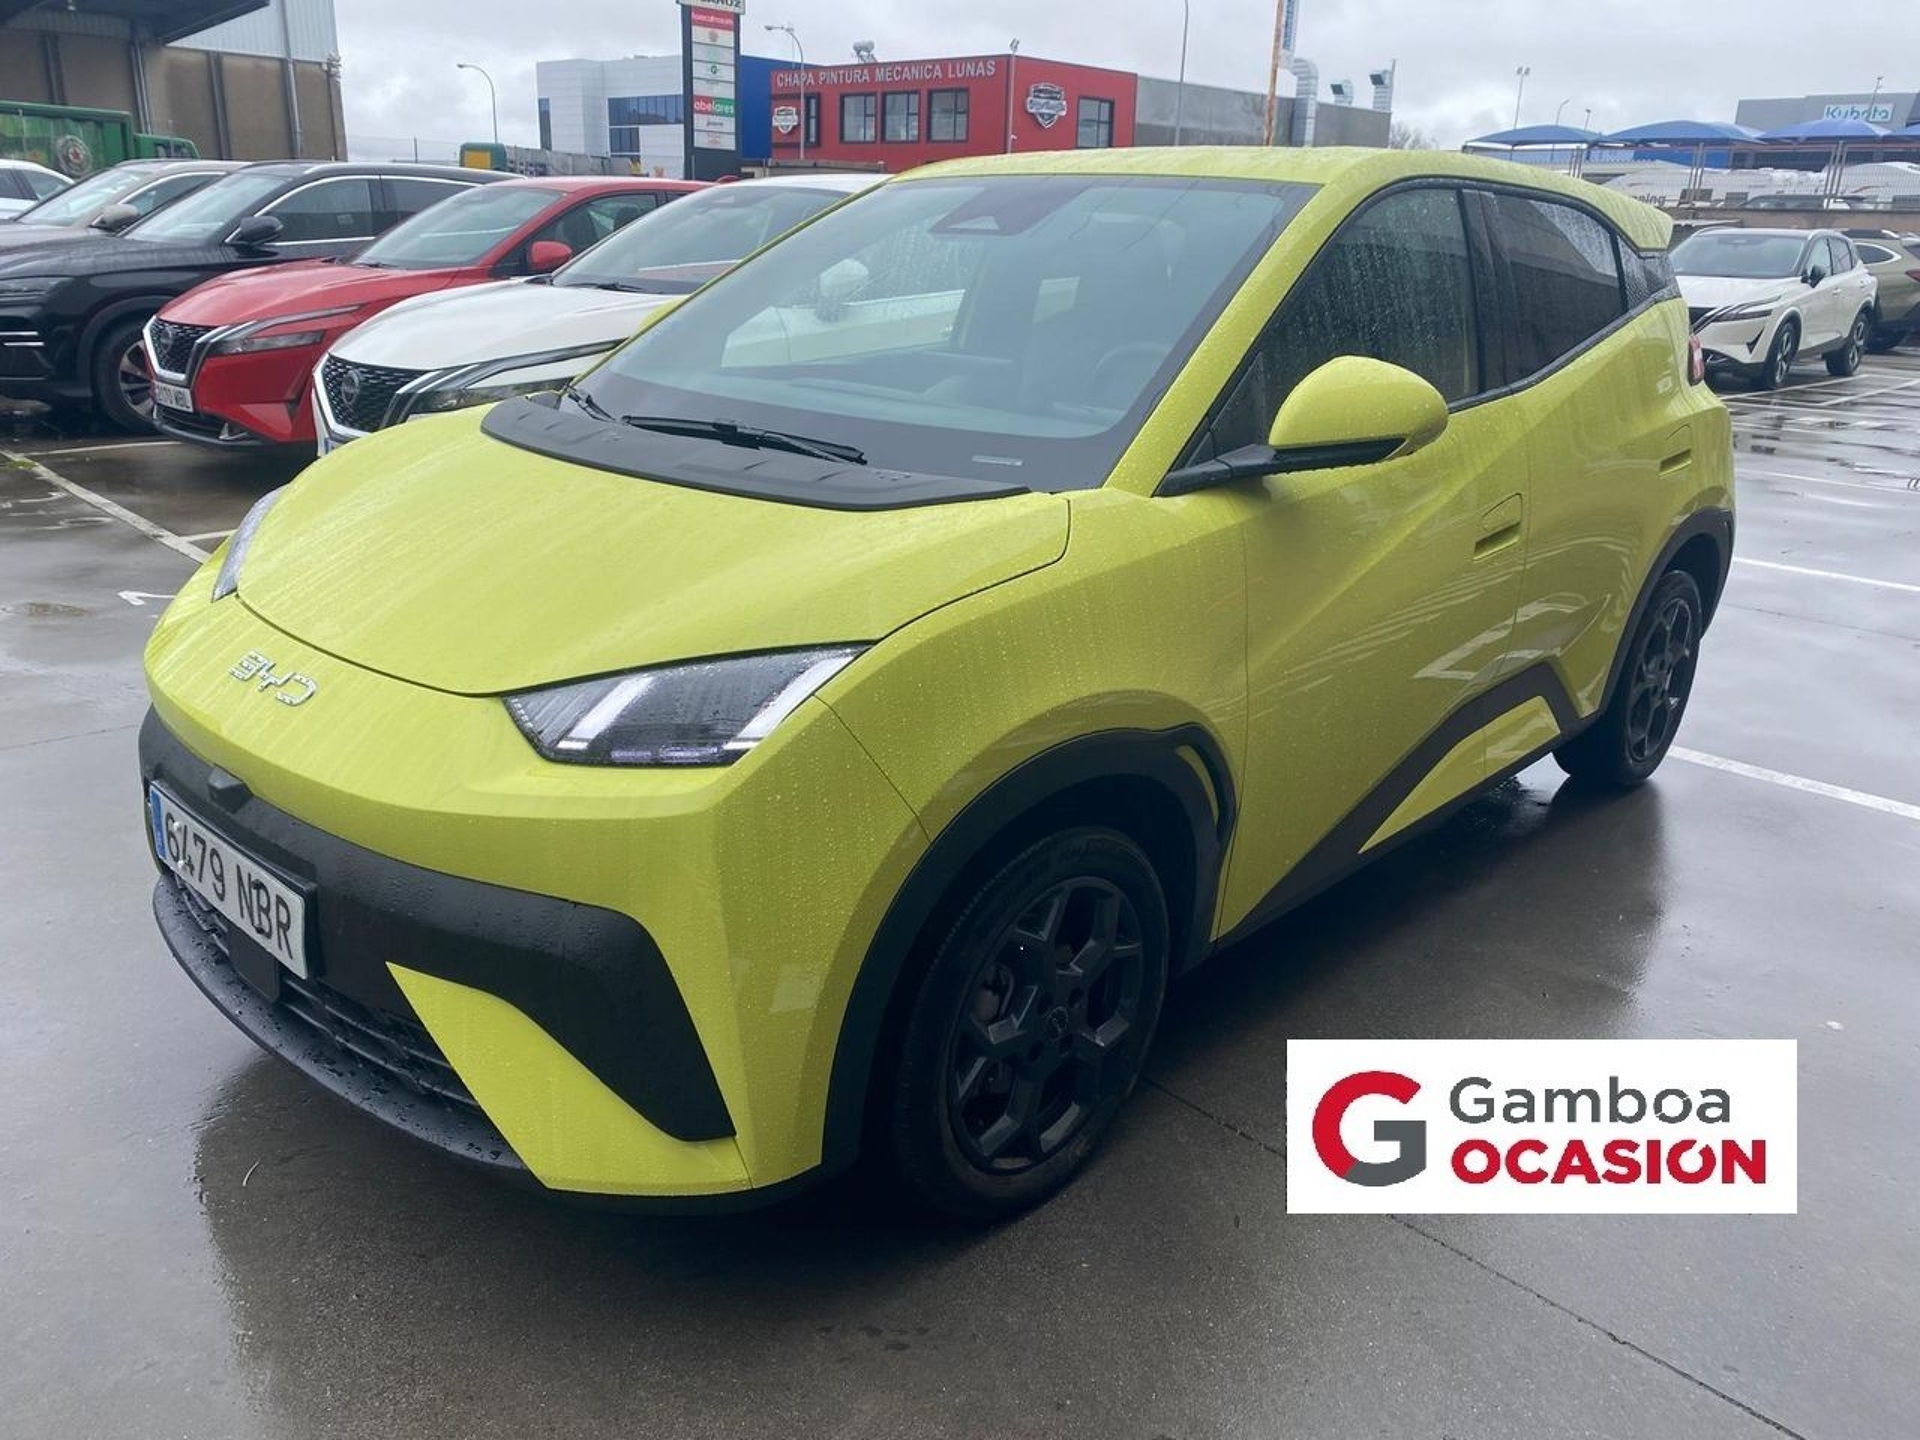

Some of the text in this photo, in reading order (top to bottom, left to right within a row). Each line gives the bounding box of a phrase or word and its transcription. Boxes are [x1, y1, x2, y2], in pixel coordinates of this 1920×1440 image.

[777, 60, 996, 87] CHAPA PINTURA MECANICA LUNAS
[1825, 105, 1889, 120] Kubota
[228, 650, 317, 706] BYD
[165, 812, 293, 960] 6479 NBR
